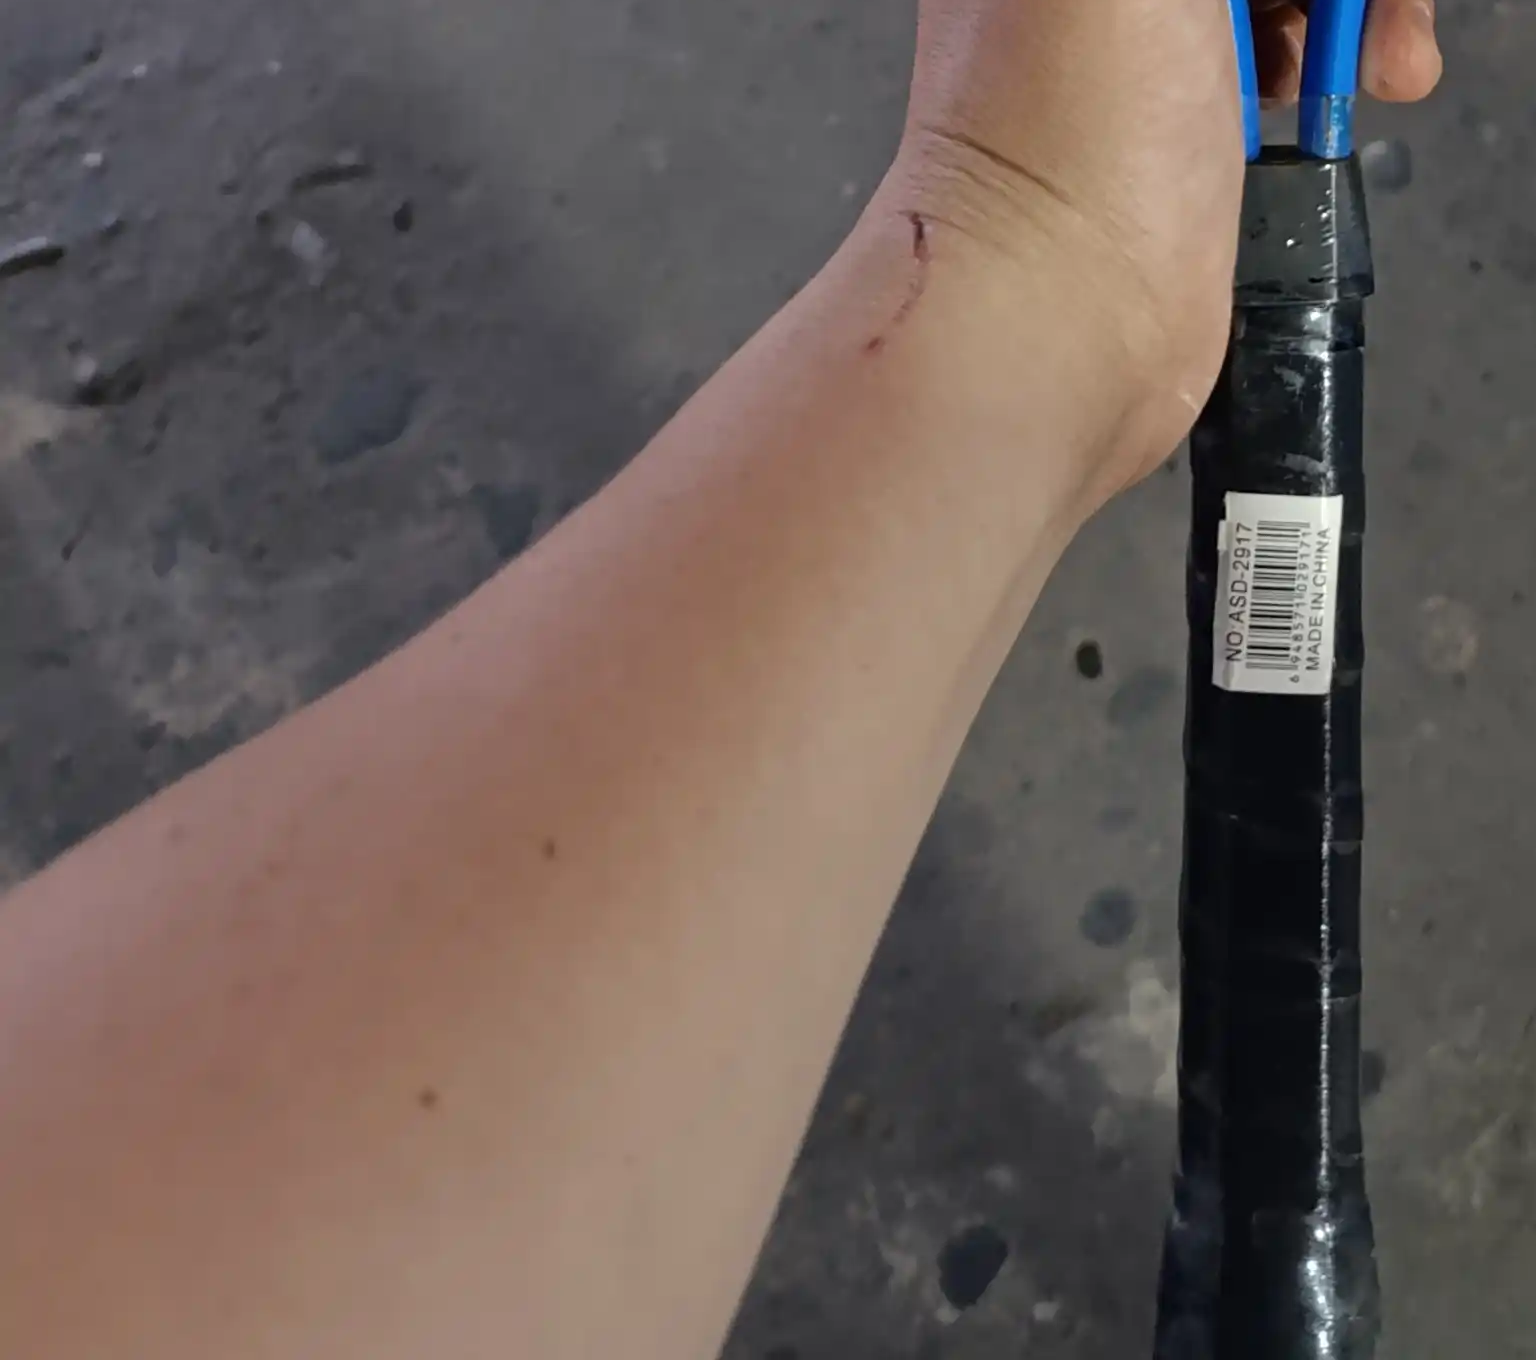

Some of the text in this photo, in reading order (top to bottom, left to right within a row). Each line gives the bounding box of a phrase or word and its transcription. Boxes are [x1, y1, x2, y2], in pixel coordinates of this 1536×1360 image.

[1305, 528, 1331, 671] MADE IN CHINA
